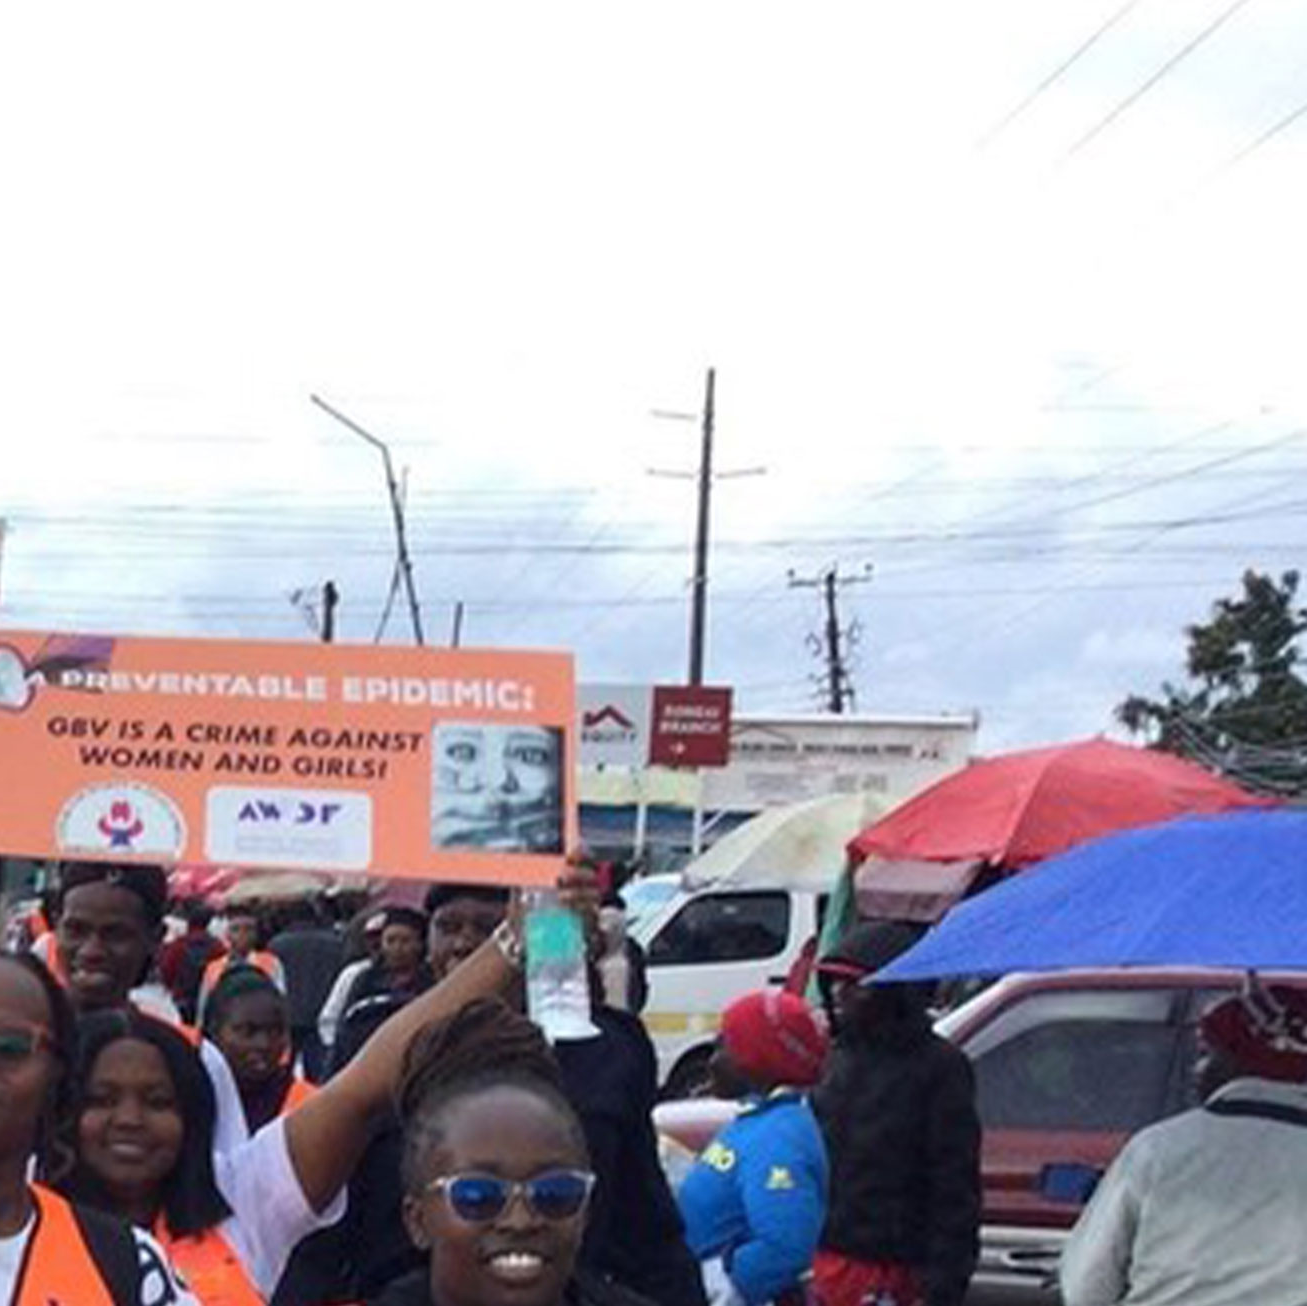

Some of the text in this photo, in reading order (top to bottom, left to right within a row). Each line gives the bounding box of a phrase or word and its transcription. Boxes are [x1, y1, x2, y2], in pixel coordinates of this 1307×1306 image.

[59, 669, 328, 700] PREVENTABLE
[342, 676, 535, 711] EPIDEMIC:
[47, 716, 424, 753] GBV IS A CRIME AGAINST
[79, 746, 390, 780] WOMEN AND GIRLS!
